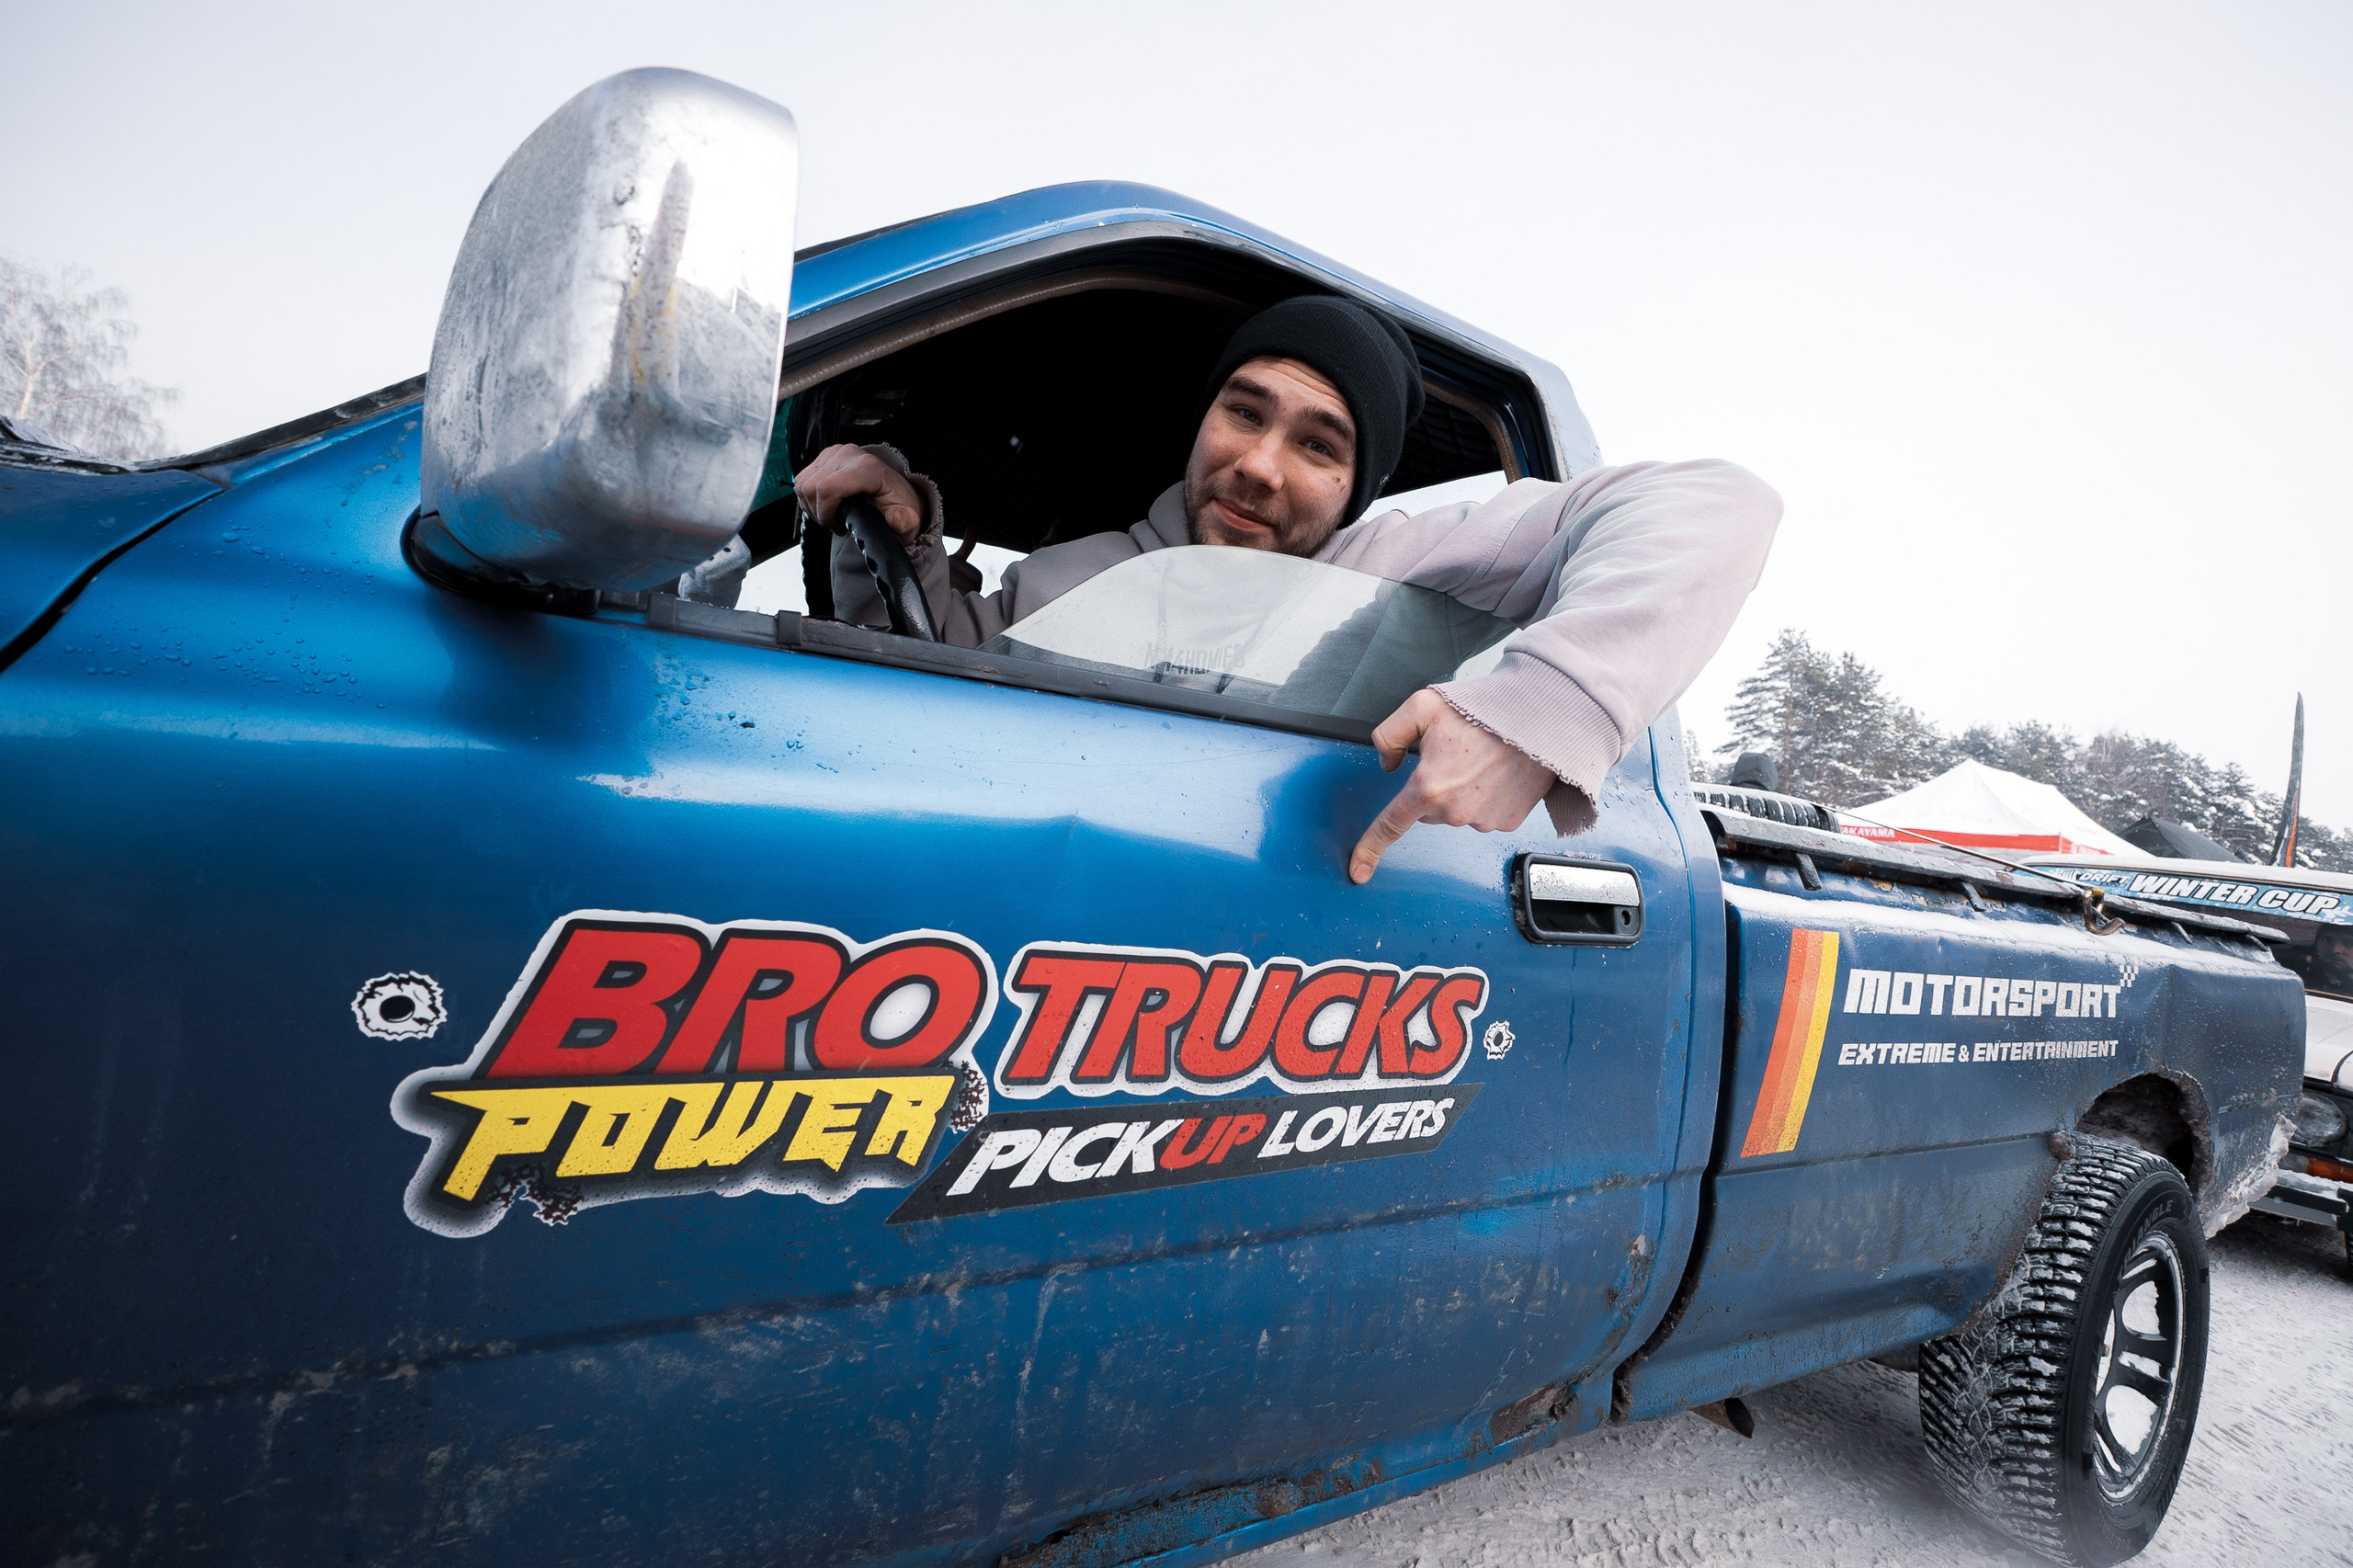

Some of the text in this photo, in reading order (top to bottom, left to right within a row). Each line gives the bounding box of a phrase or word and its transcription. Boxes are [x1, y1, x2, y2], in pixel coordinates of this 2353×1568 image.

[1841, 827, 1895, 838] AKAYAMA
[2078, 872, 2340, 915] DRIFT WINTER CUP
[483, 925, 1483, 1080] BRO TRUCKS
[1842, 968, 2121, 1018] MOTORSPORT
[1838, 1040, 2119, 1066] EXTREME & ENTERTAINMENT
[430, 1075, 955, 1201] POWER
[946, 1097, 1455, 1196] PICKUP LOVERS
